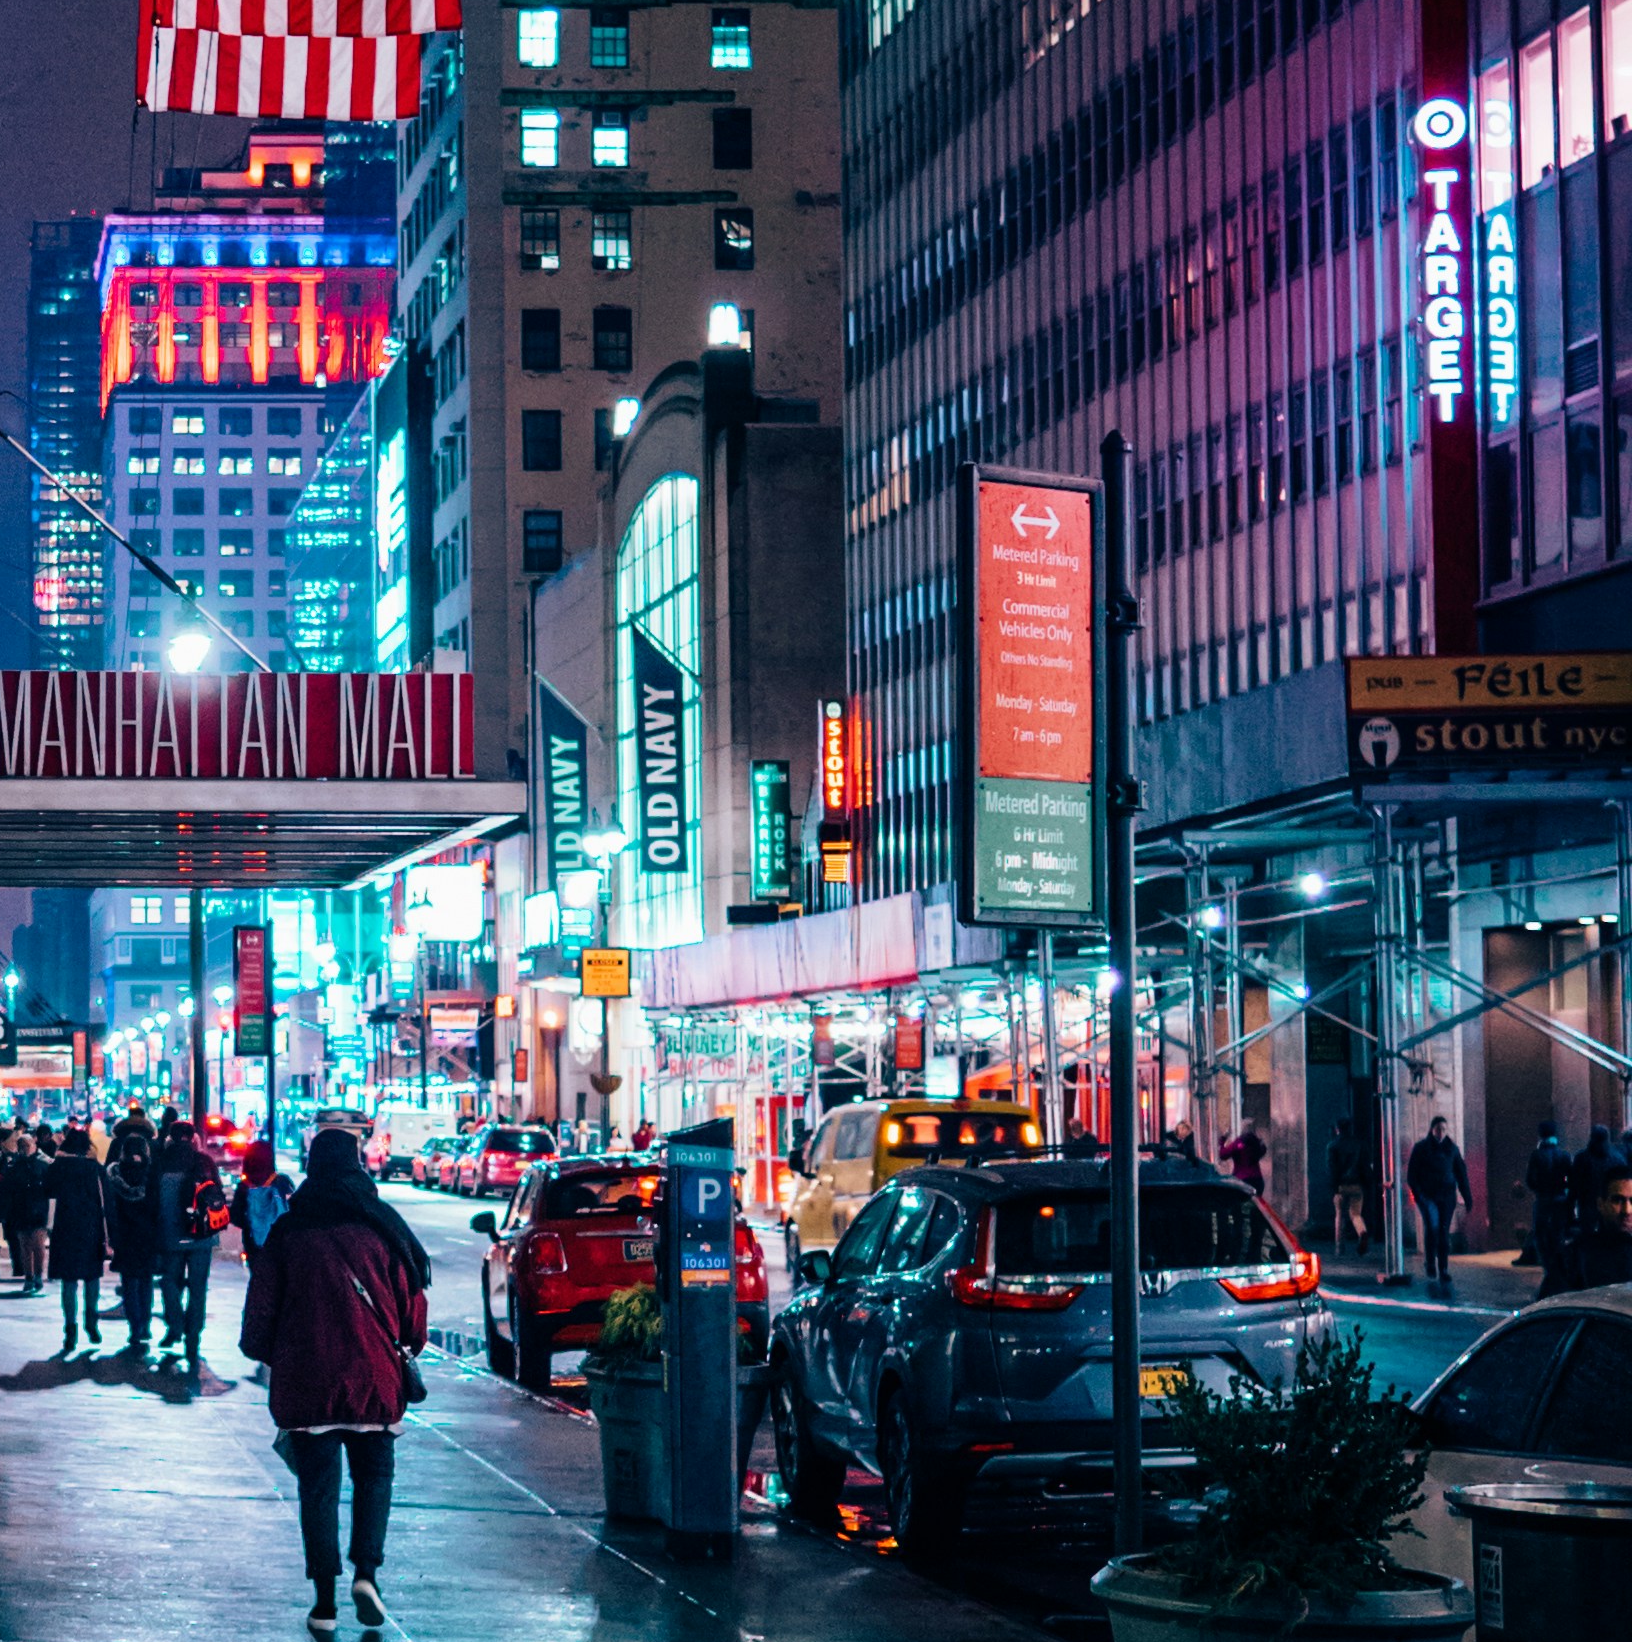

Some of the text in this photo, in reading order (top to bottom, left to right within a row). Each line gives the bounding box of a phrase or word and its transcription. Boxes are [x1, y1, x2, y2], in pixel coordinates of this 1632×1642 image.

[1423, 169, 1463, 422] TARGET
[993, 544, 1079, 572] Metered Parking
[1016, 571, 1057, 588] 3 Hr Limit
[1002, 598, 1070, 619] Commercial
[999, 621, 1073, 645] Vehicles Only
[1000, 651, 1073, 673] Others No Standing
[995, 693, 1032, 714] Monday
[1039, 696, 1077, 717] Saturday
[339, 671, 477, 779] MALL
[1013, 726, 1019, 740] 7
[1020, 730, 1034, 742] am
[1039, 729, 1046, 744] 6
[1047, 731, 1062, 746] pm
[1415, 717, 1628, 755] stout nyc
[643, 683, 681, 865] OLD NAVY
[826, 720, 844, 808] stout
[549, 734, 585, 872] LD NAVY
[986, 790, 1087, 824] Metered Parking
[758, 784, 769, 884] BLARNEY
[774, 812, 786, 871] ROCK
[1013, 826, 1065, 844] 6 Hr Limit
[995, 850, 1002, 868] 6
[1004, 853, 1022, 873] pm
[1032, 851, 1079, 875] Midnight
[997, 877, 1033, 898] Monday
[1039, 878, 1076, 899] Saturday
[675, 1152, 717, 1163] 106301
[698, 1176, 722, 1214] P
[685, 1257, 726, 1269] 106301
